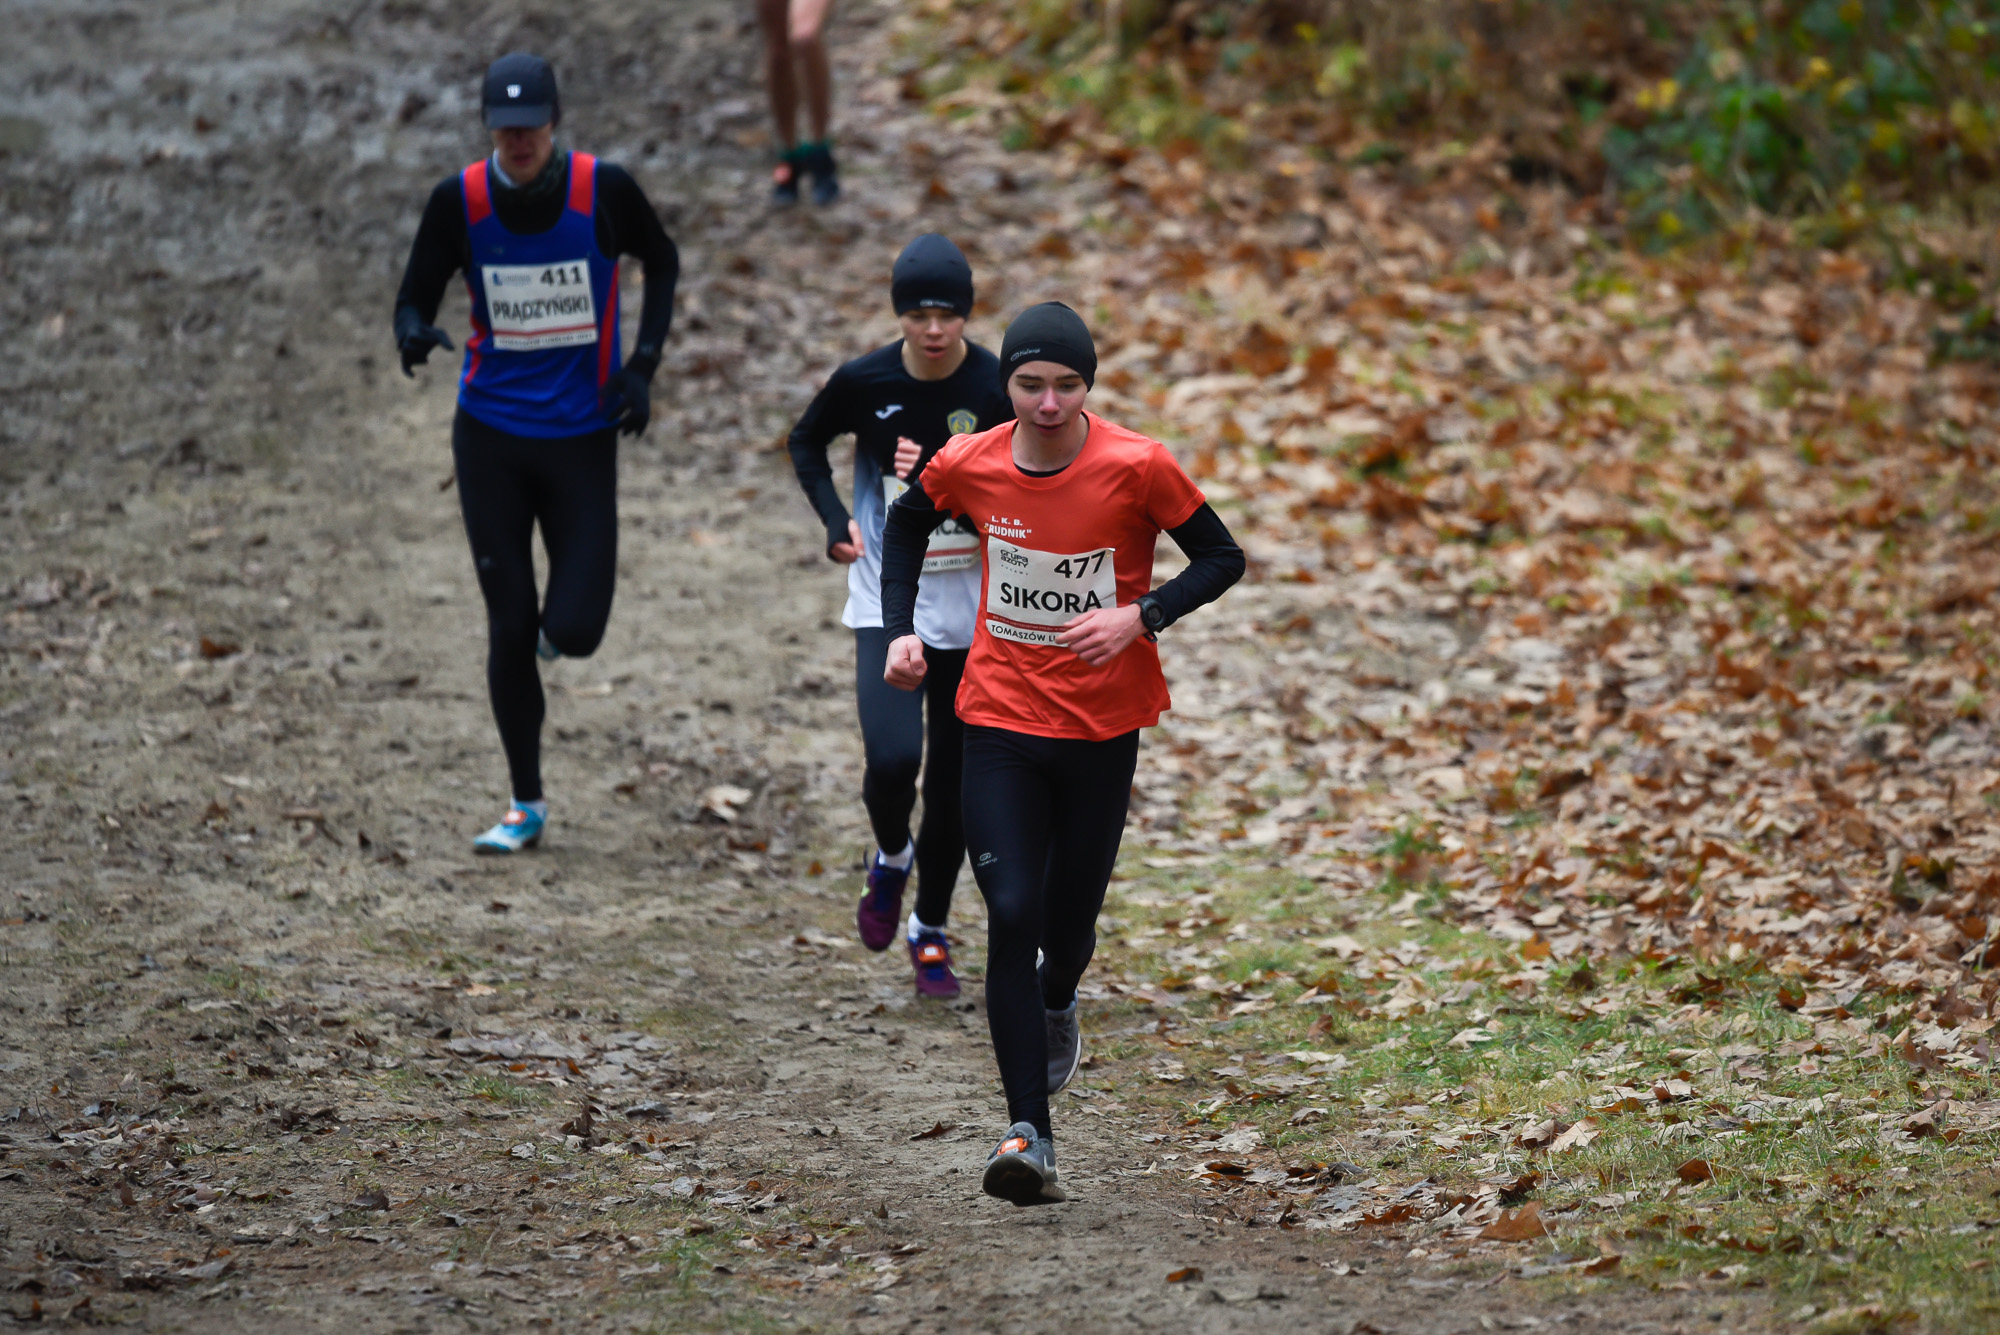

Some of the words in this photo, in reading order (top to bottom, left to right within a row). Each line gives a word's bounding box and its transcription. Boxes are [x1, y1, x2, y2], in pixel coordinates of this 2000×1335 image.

[540, 265, 583, 286] 411
[492, 293, 590, 325] PRĄDZYŃSKI
[991, 515, 999, 523] L.
[1001, 517, 1011, 525] K.
[1053, 550, 1106, 579] 477
[1000, 582, 1102, 614] SIKORA
[991, 624, 1047, 642] TOMASZÓW
